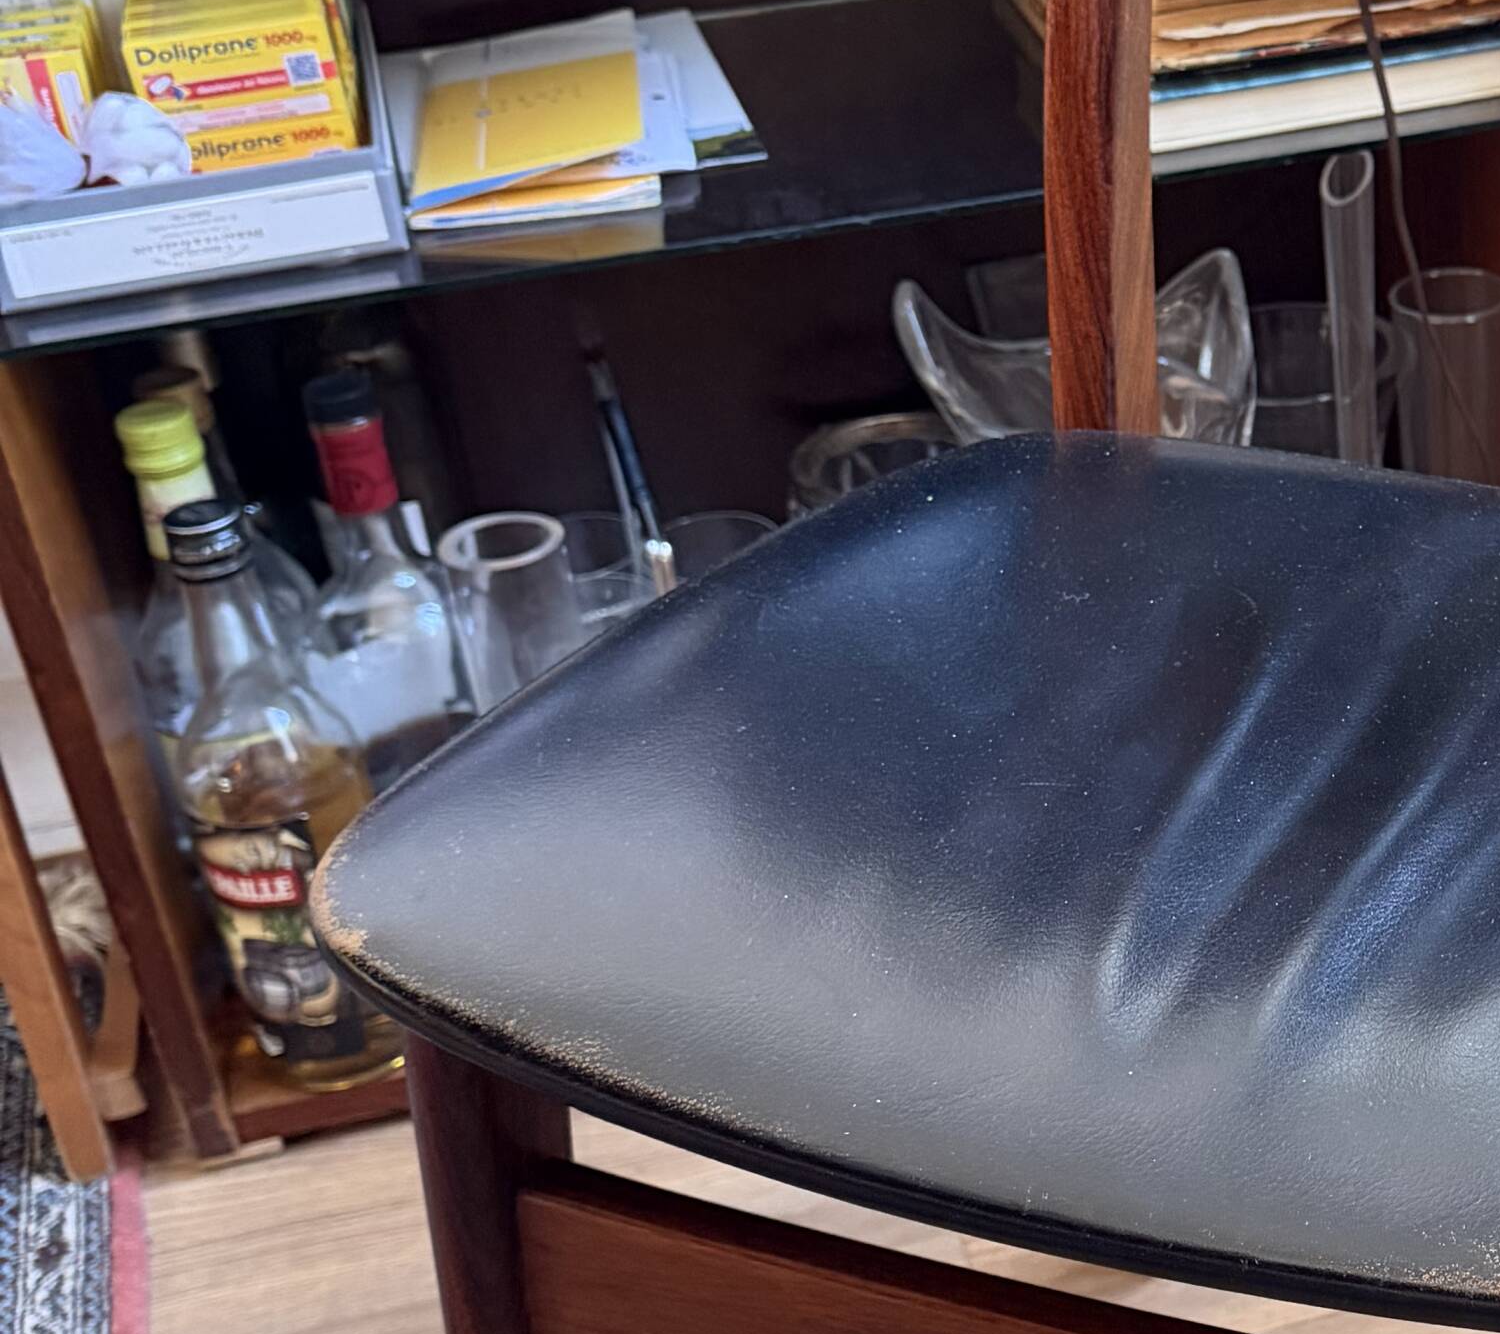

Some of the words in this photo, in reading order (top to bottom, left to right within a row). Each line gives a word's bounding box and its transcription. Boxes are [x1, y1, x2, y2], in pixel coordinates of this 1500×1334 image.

[134, 35, 258, 67] Doliprane
[263, 31, 303, 47] 1000
[191, 132, 286, 160] oliprane
[291, 126, 330, 143] 1000
